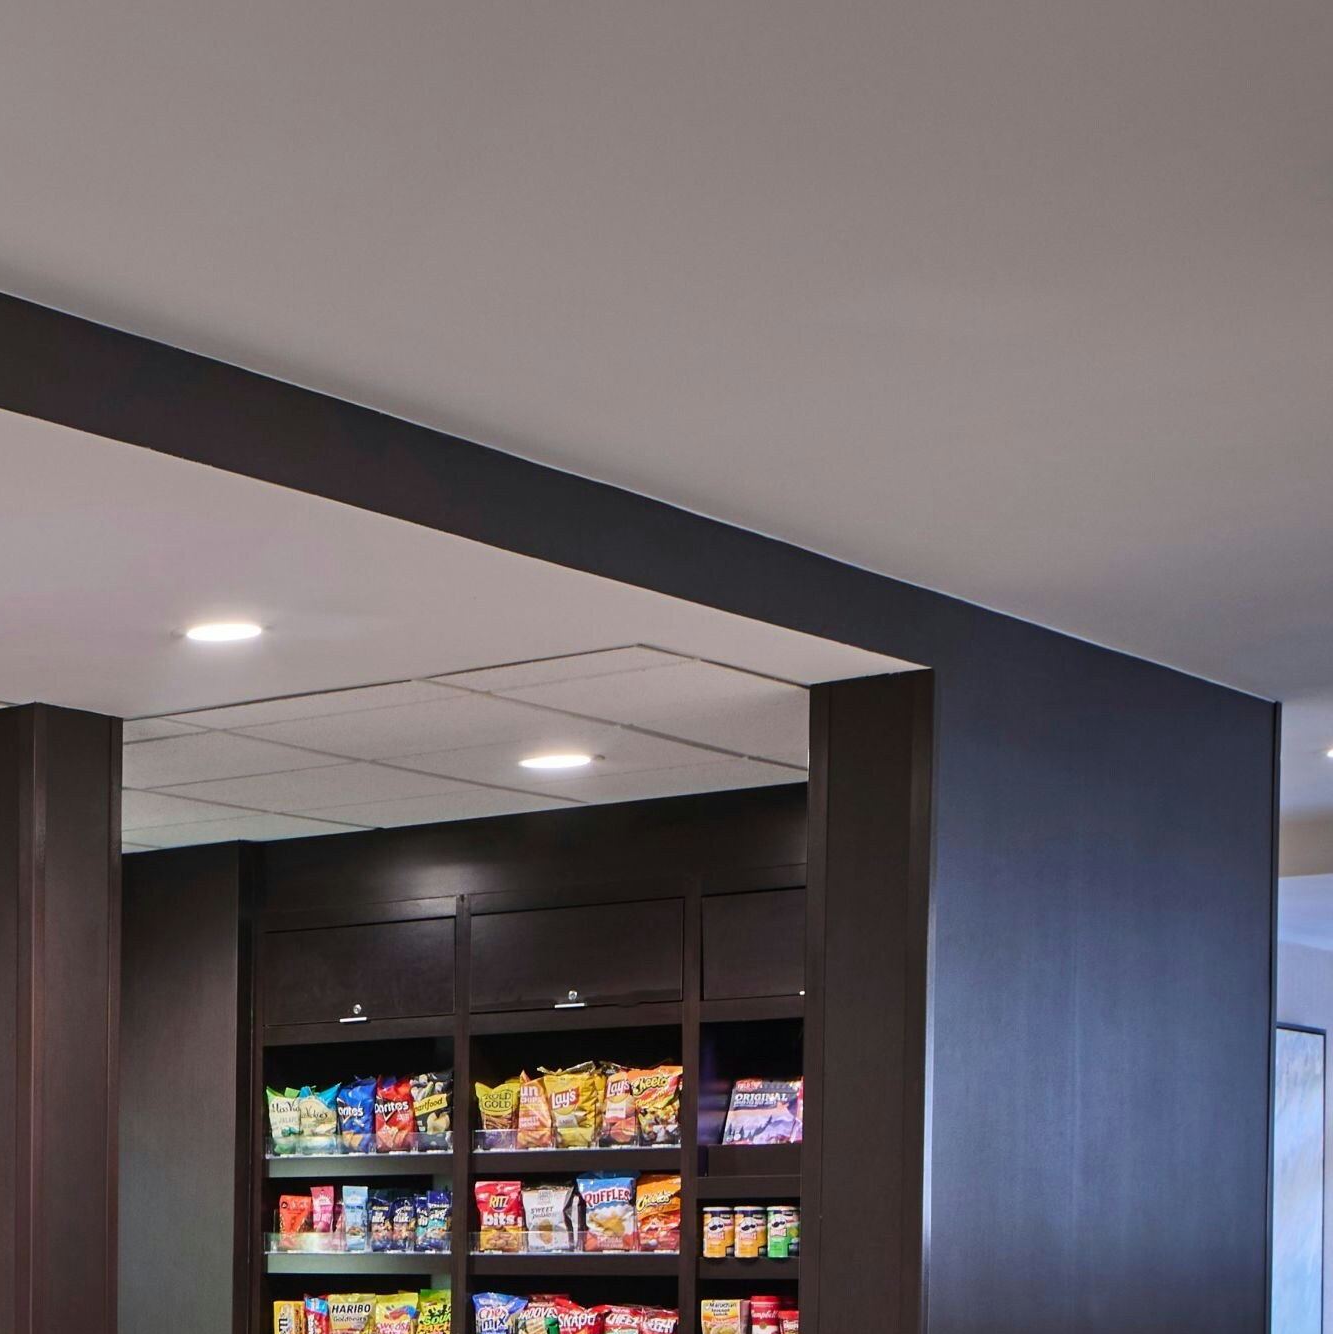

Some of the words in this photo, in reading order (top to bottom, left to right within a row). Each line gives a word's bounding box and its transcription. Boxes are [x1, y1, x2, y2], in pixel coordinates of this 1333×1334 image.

[552, 1089, 577, 1109] Lay's
[735, 1092, 788, 1102] ORIGINAL
[483, 1099, 512, 1110] GOLD
[489, 1195, 509, 1208] RITZ
[584, 1188, 631, 1209] RUFFLES
[483, 1211, 516, 1226] bits
[332, 1303, 371, 1314] HARIBO
